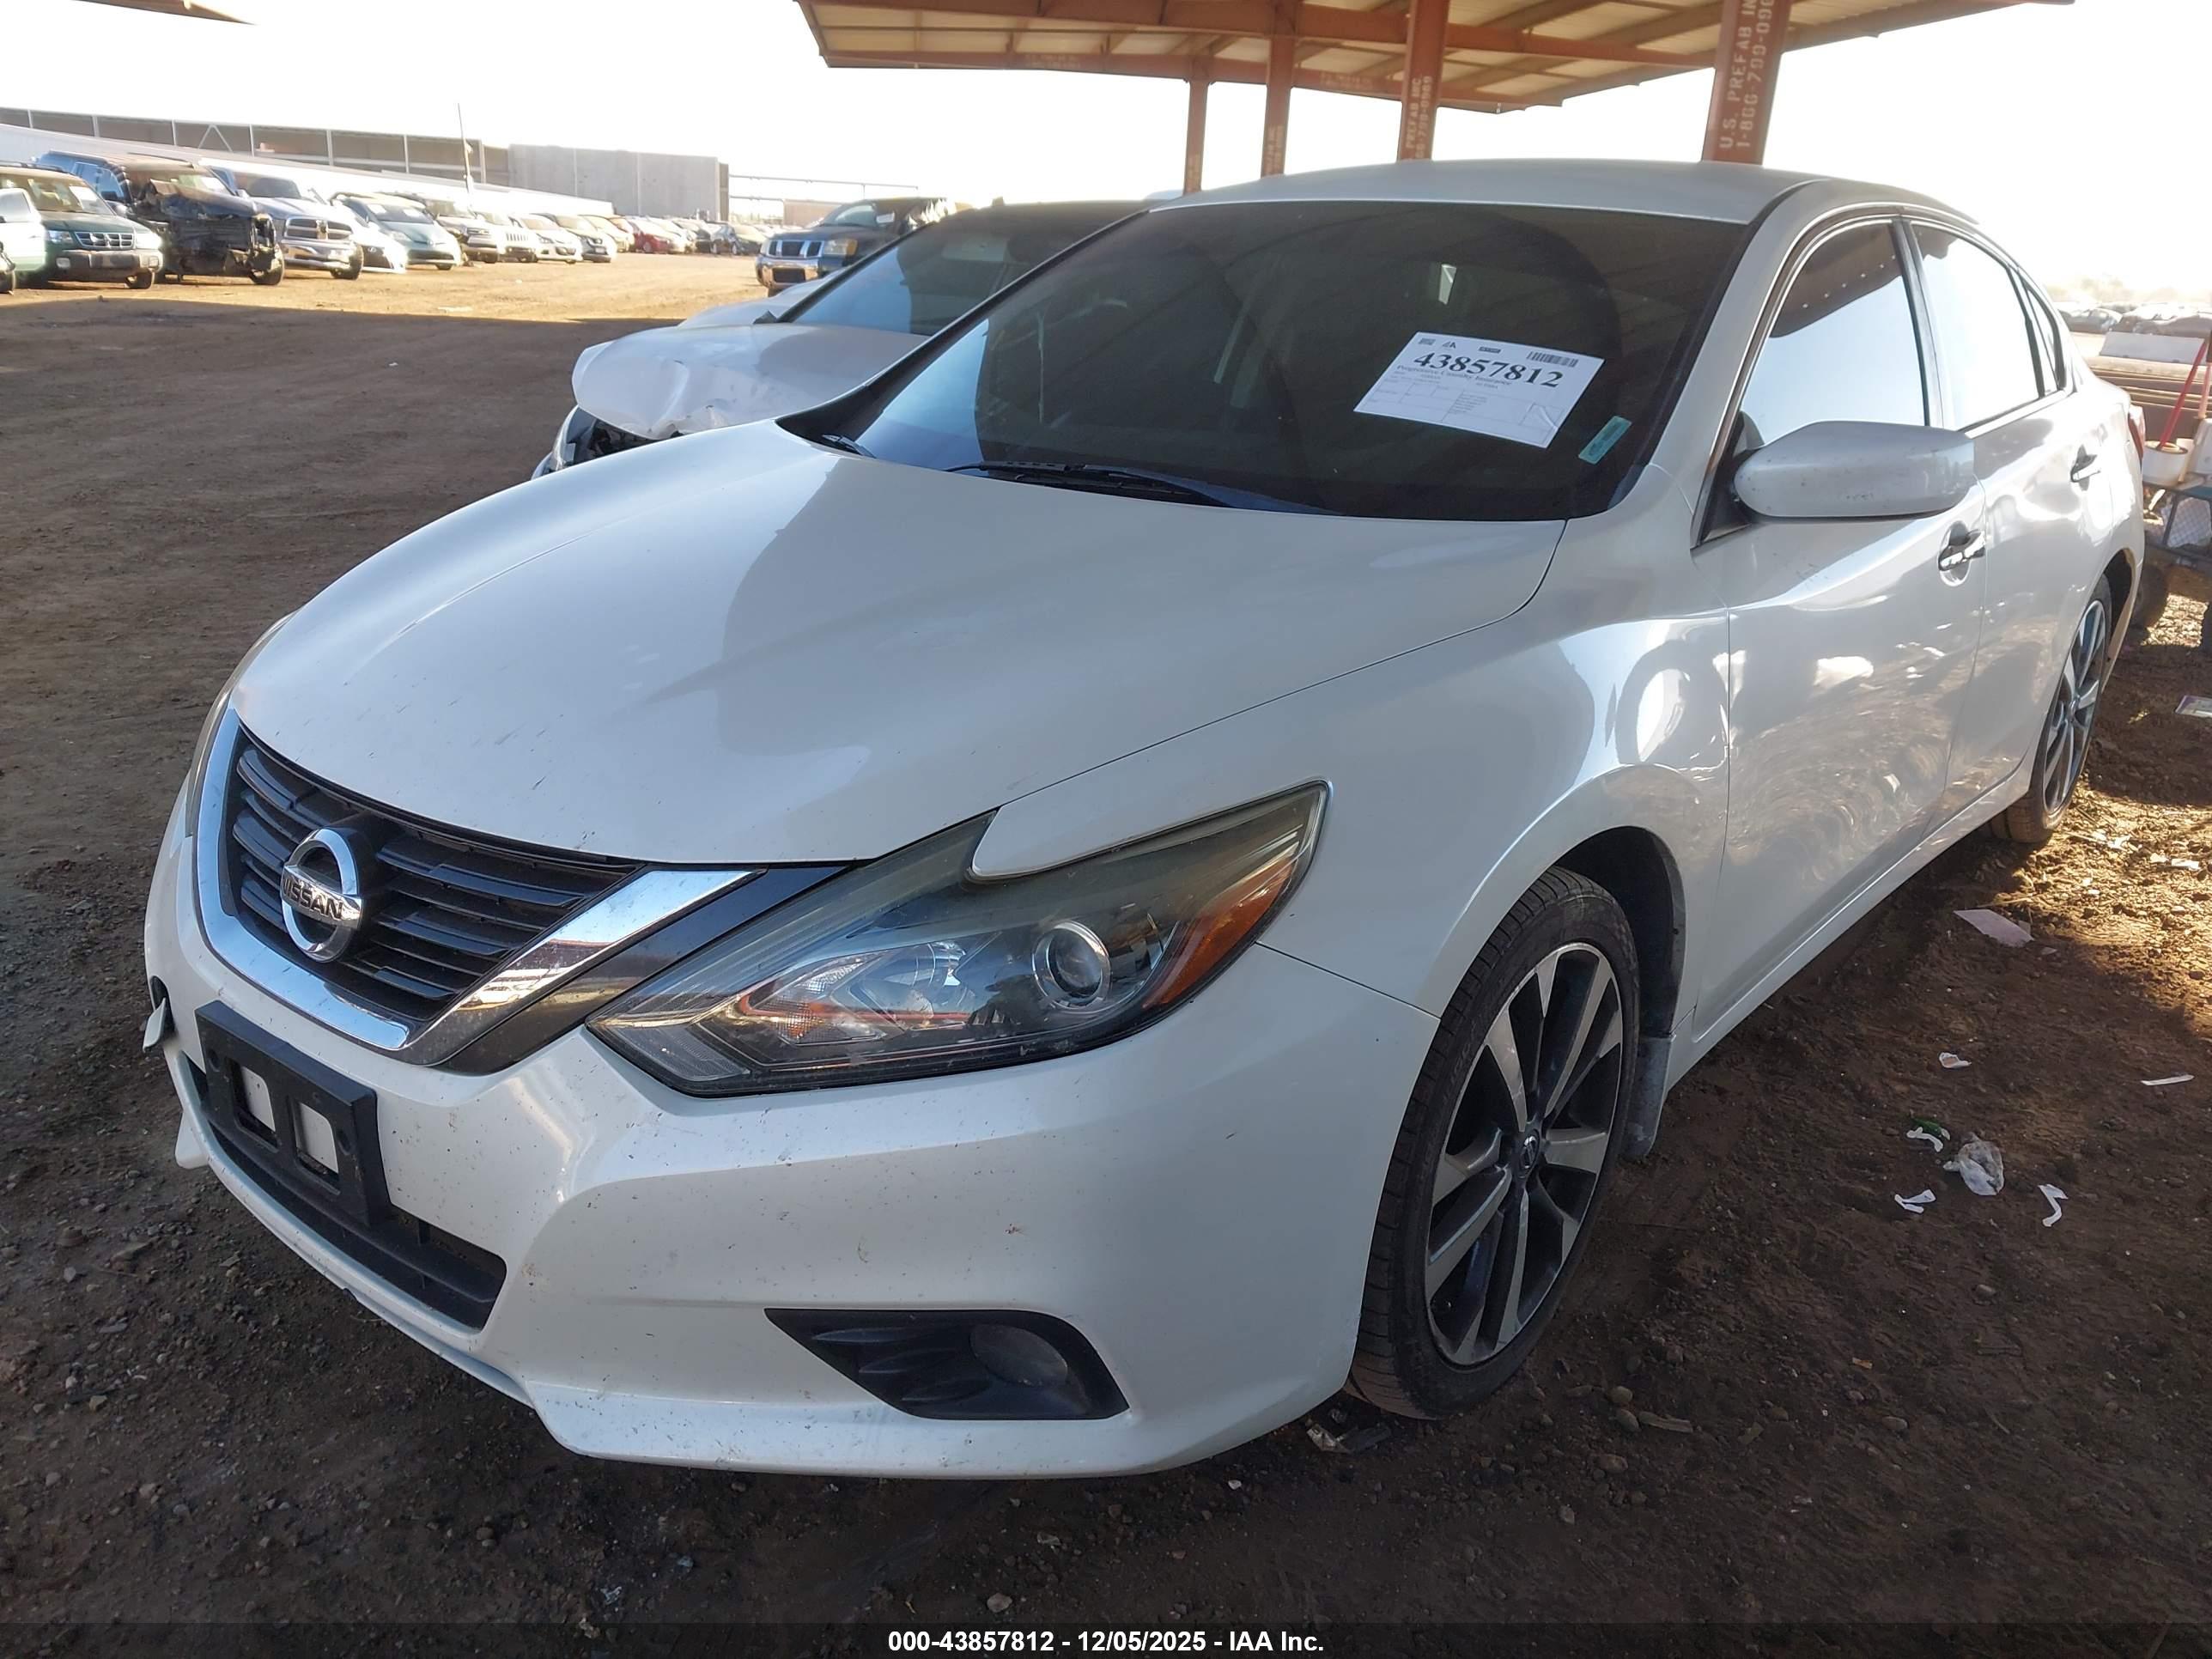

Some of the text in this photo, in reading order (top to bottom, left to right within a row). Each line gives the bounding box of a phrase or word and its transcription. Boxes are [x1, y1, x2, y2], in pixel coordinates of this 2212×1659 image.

[1728, 27, 1752, 102] PREFAB
[1719, 112, 1738, 148] U.S.
[1413, 352, 1563, 387] 43857812
[283, 876, 343, 921] NISSAN
